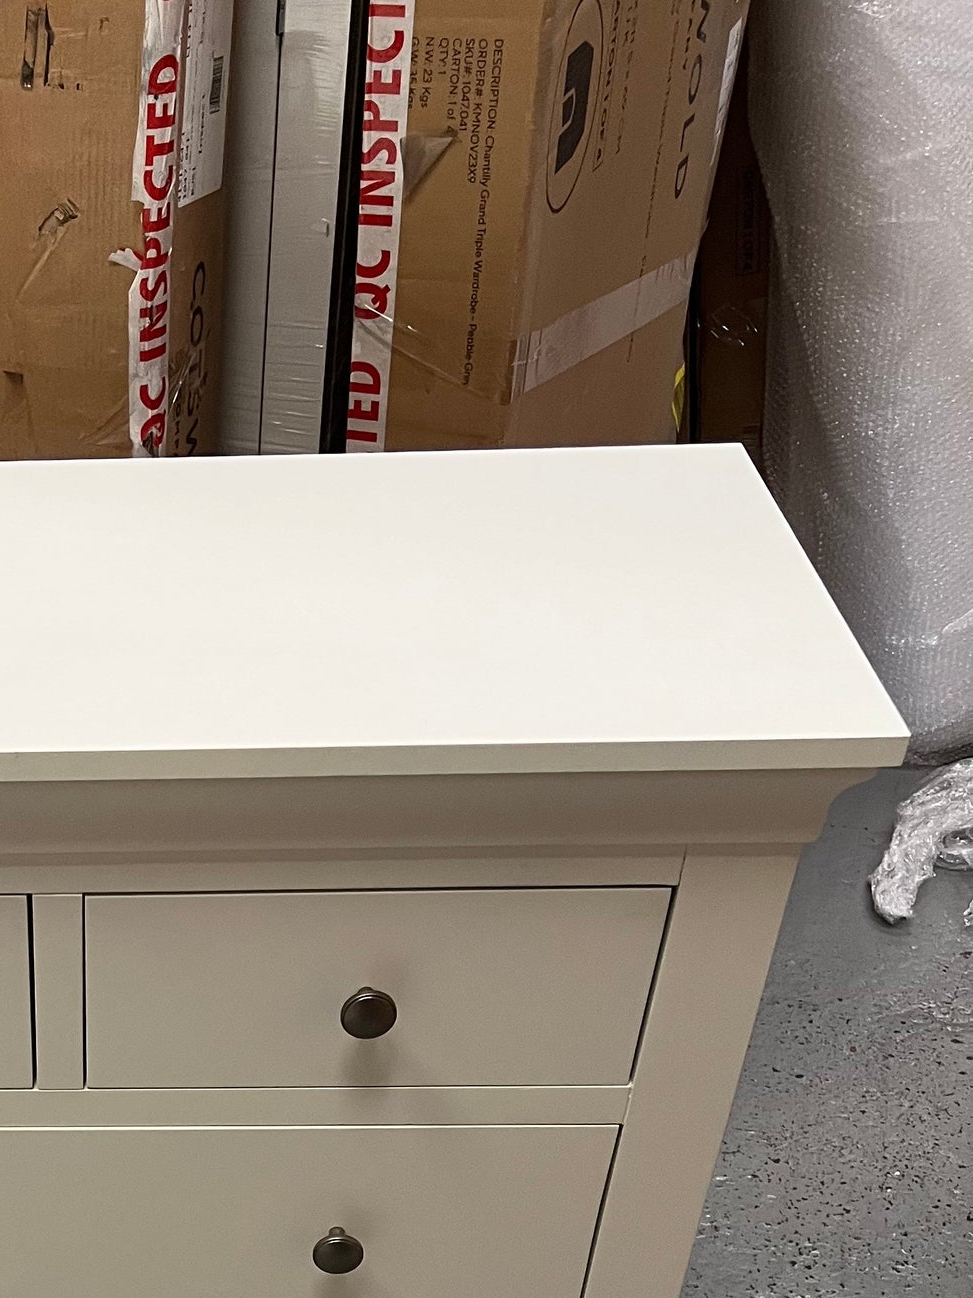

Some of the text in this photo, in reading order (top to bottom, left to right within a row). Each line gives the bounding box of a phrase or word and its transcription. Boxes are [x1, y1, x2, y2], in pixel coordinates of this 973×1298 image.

[420, 86, 431, 109] Kgs
[422, 68, 433, 84] 23
[446, 108, 456, 120] of
[459, 81, 472, 132] 1047.041
[467, 102, 483, 184] KMNOV23X9
[479, 135, 495, 188] Chantilly
[139, 54, 180, 363] INSPECTED
[478, 189, 490, 225] Grand
[475, 227, 487, 258] Triple
[354, 249, 391, 320] QC
[469, 260, 483, 315] Wardrobe
